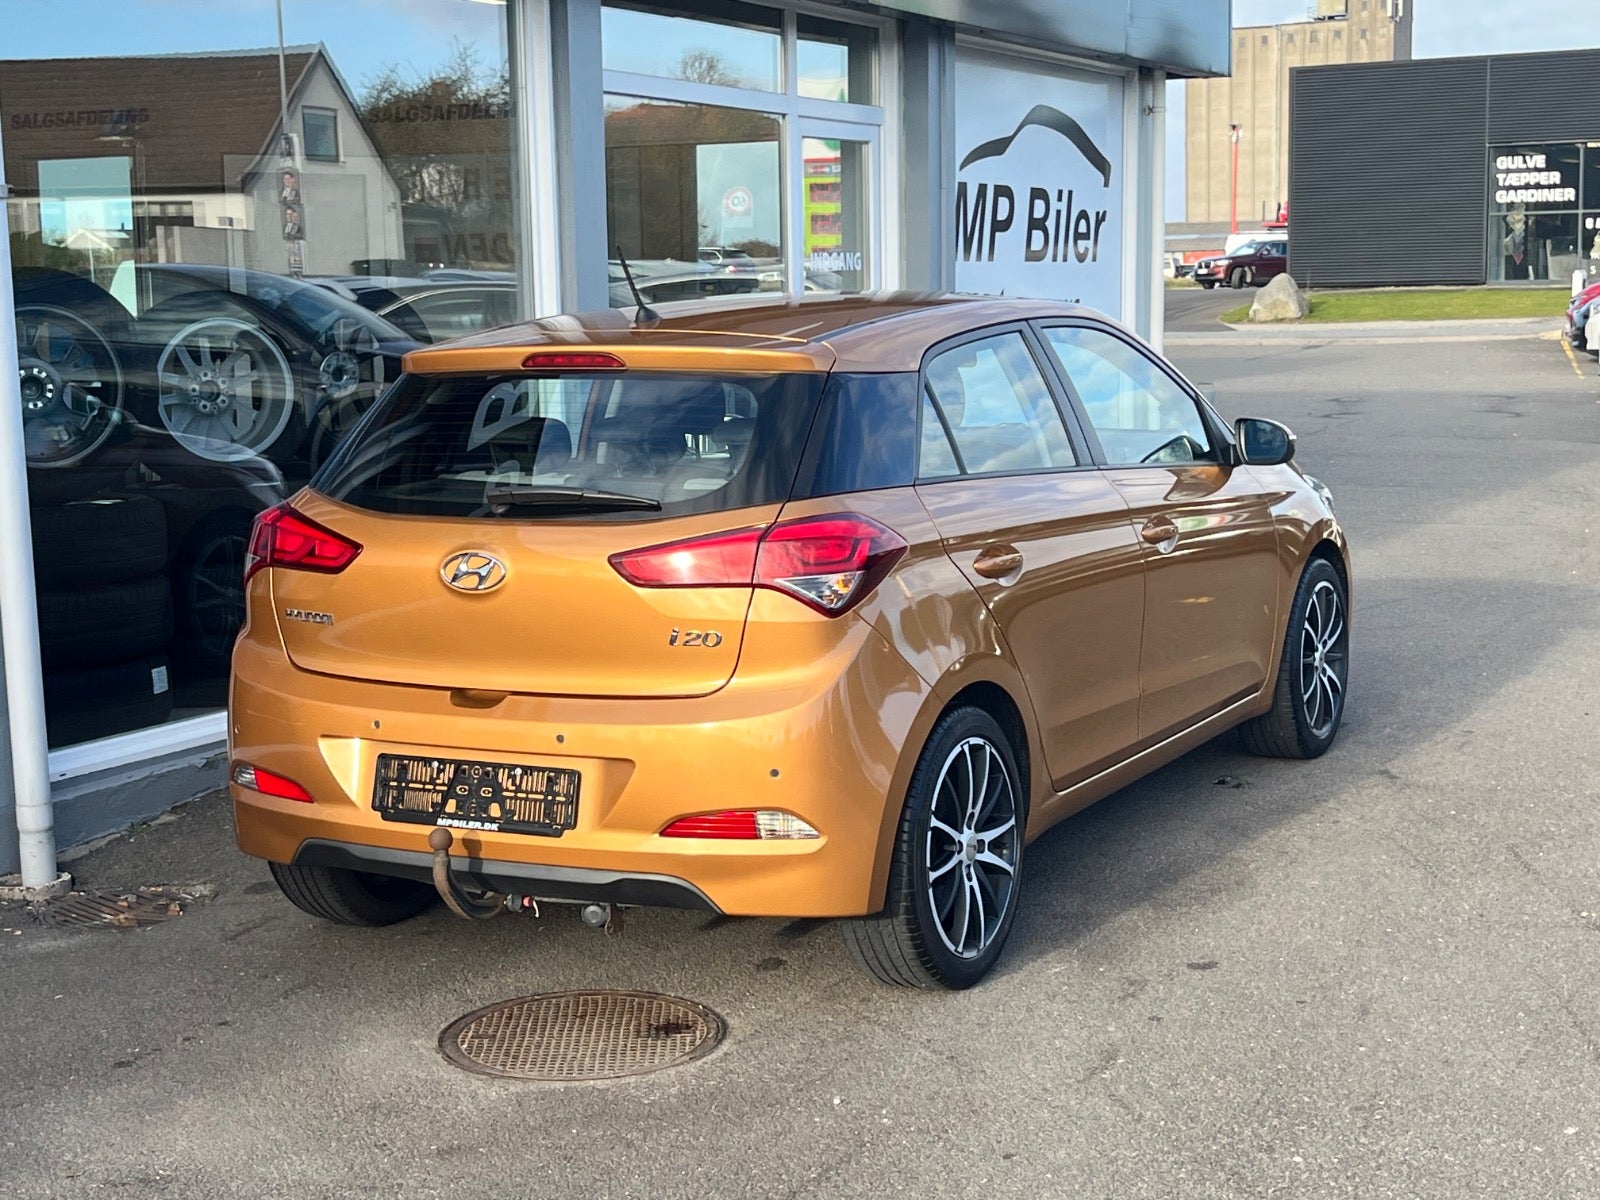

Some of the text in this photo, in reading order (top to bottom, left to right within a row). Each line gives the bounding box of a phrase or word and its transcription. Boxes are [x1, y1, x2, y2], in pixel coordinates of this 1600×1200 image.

[1496, 155, 1546, 169] GULVE
[1496, 171, 1561, 186] TÆPPER
[1495, 187, 1576, 203] GARDINER
[955, 181, 1108, 263] MP Biler
[669, 627, 723, 648] i20
[436, 817, 500, 832] MPBILER.DK
